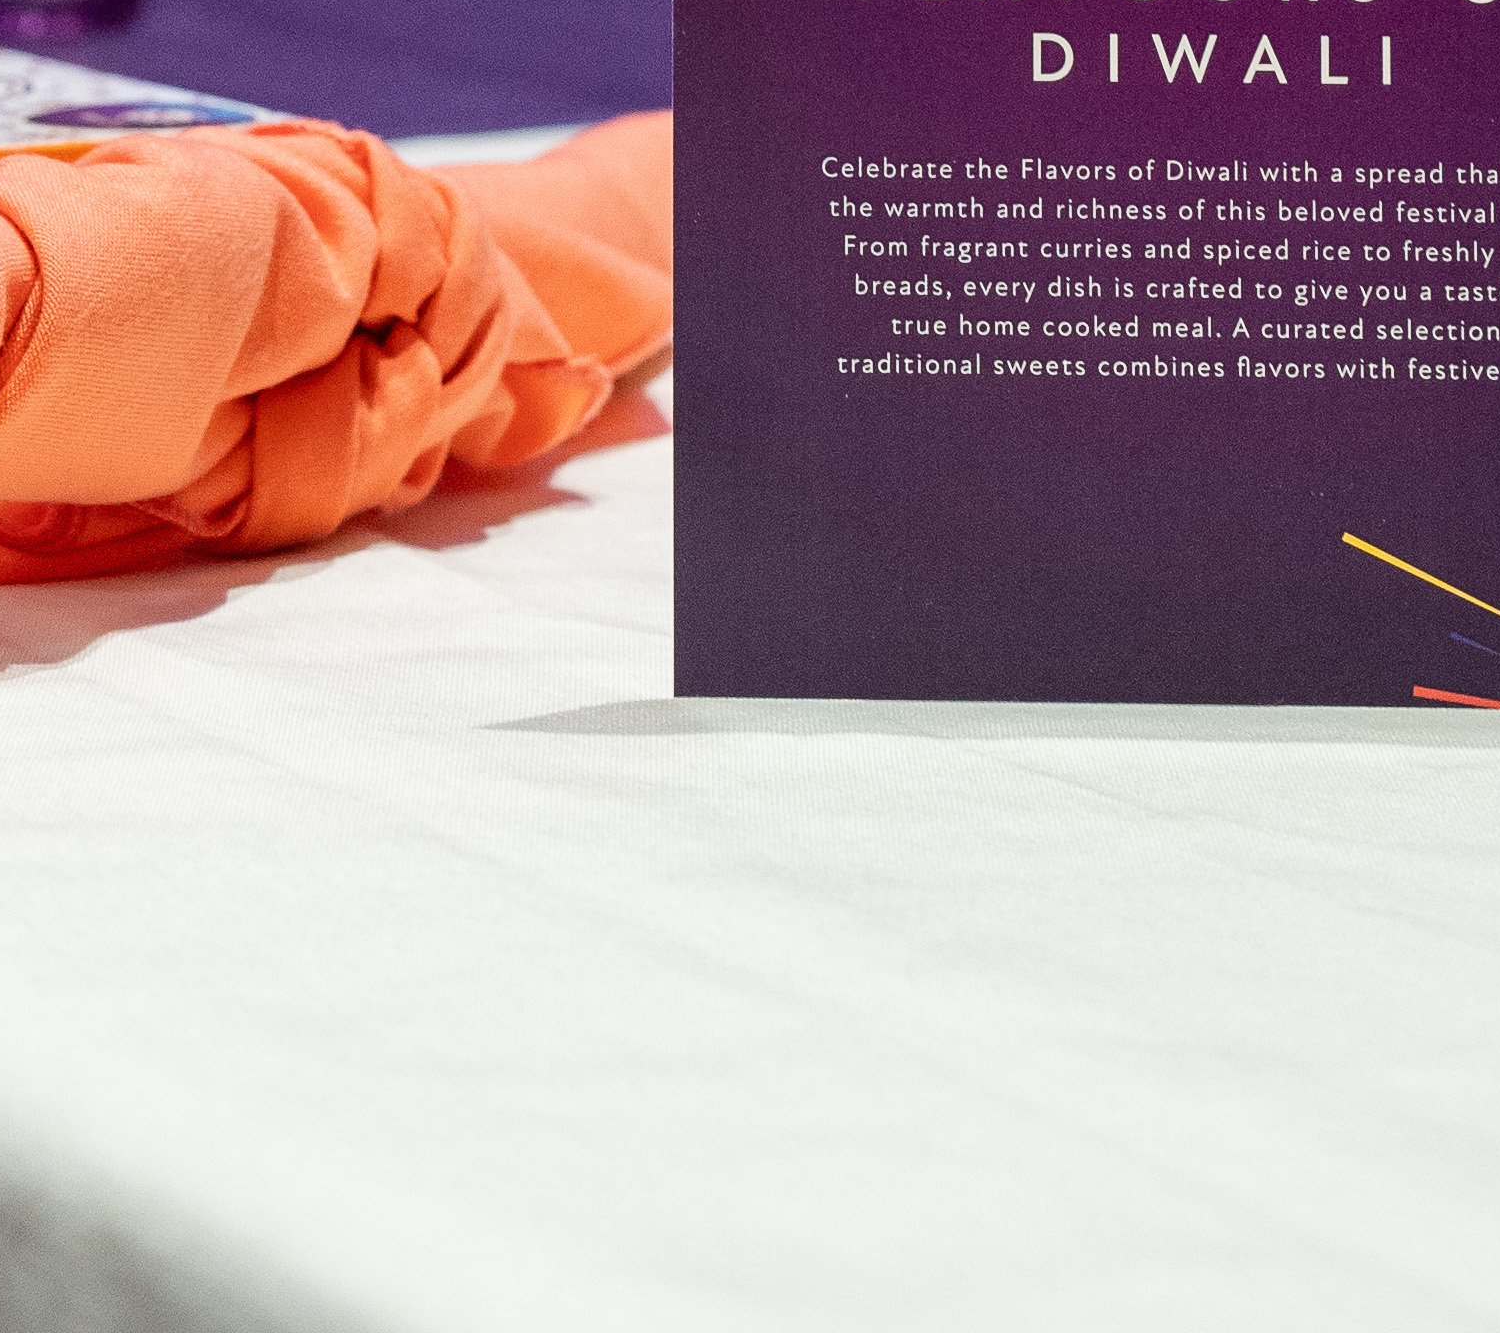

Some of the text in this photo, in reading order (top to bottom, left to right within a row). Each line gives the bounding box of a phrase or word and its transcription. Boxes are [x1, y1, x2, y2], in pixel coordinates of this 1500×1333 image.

[1032, 32, 1392, 86] DIWALI
[821, 156, 953, 179] Celebrate
[964, 157, 1009, 180] the
[1021, 157, 1116, 181] Flavors
[1128, 158, 1156, 181] of
[1166, 159, 1248, 182] Diwali
[1259, 160, 1318, 183] with
[1330, 167, 1343, 183] a
[1355, 161, 1444, 190] spread
[829, 195, 873, 218] the
[884, 196, 984, 219] warmth
[996, 196, 1043, 219] and
[1056, 197, 1167, 221] richness
[1178, 198, 1206, 221] of
[1216, 198, 1266, 221] this
[1278, 199, 1383, 223] beloved
[1396, 200, 1495, 224] festival
[844, 234, 908, 257] From
[920, 234, 1029, 264] fragrant
[1040, 237, 1132, 259] curries
[1144, 237, 1191, 260] and
[1203, 238, 1289, 266] spiced
[1302, 240, 1351, 261] rice
[1363, 244, 1391, 262] to
[1402, 239, 1495, 269] freshly
[855, 273, 952, 300] breads,
[963, 280, 1036, 304] every
[1047, 275, 1102, 298] dish
[1114, 277, 1134, 298] is
[1146, 276, 1242, 299] crafted
[1254, 282, 1283, 300] to
[1294, 279, 1349, 307] give
[1359, 285, 1407, 307] you
[1419, 285, 1432, 301] a
[891, 318, 947, 336] true
[959, 313, 1031, 337] home
[1042, 314, 1139, 338] cooked
[1152, 316, 1222, 338] meal.
[1232, 317, 1250, 339] A
[1261, 317, 1364, 340] curated
[1376, 318, 1500, 342] selection
[837, 351, 981, 375] traditional
[993, 359, 1086, 376] sweets
[1097, 354, 1225, 378] combines
[1236, 355, 1326, 379] flavors
[1336, 356, 1395, 380] with
[1407, 357, 1500, 381] festive
